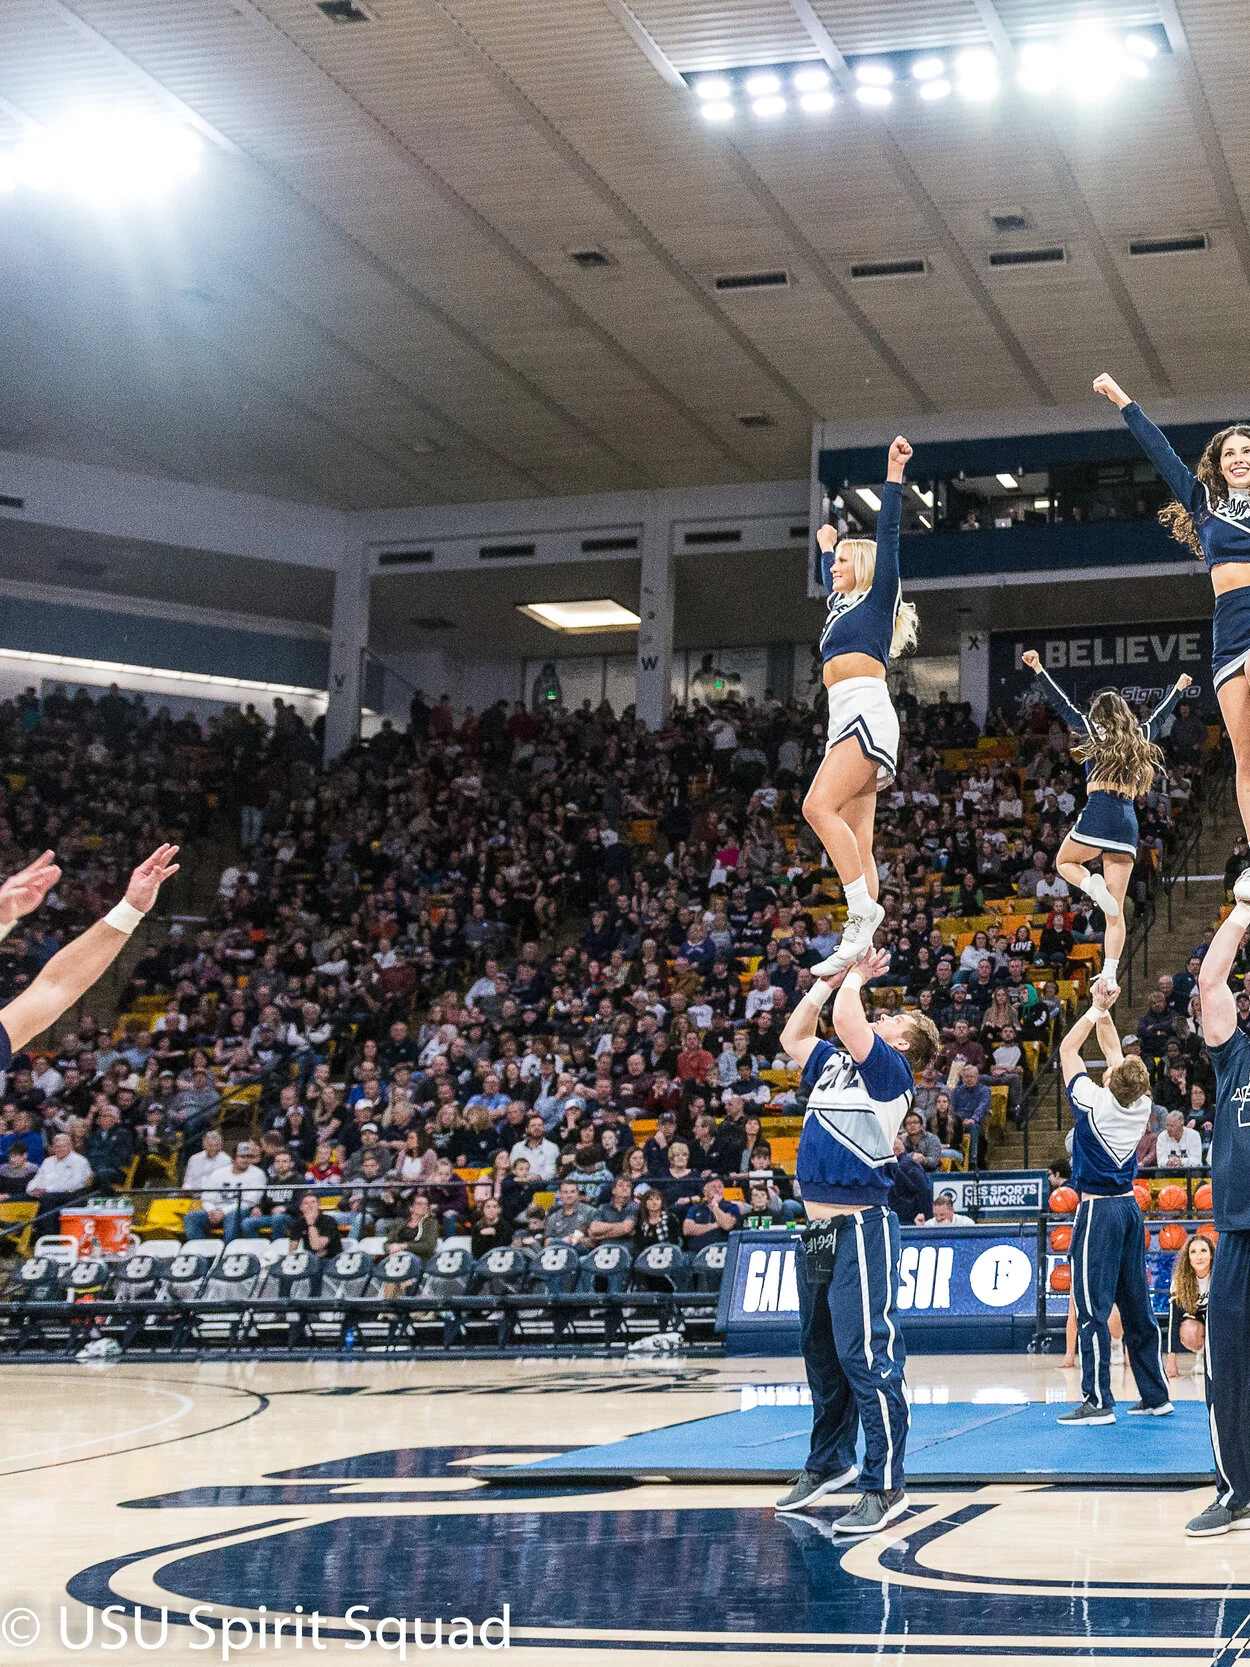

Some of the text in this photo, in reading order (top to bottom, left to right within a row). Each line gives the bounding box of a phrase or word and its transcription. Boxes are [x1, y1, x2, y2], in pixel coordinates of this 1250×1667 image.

[968, 636, 981, 651] X
[1045, 632, 1202, 669] BELIEVE
[641, 655, 659, 671] W
[1010, 941, 1033, 953] LOVE
[990, 1184, 1038, 1197] SPORTS
